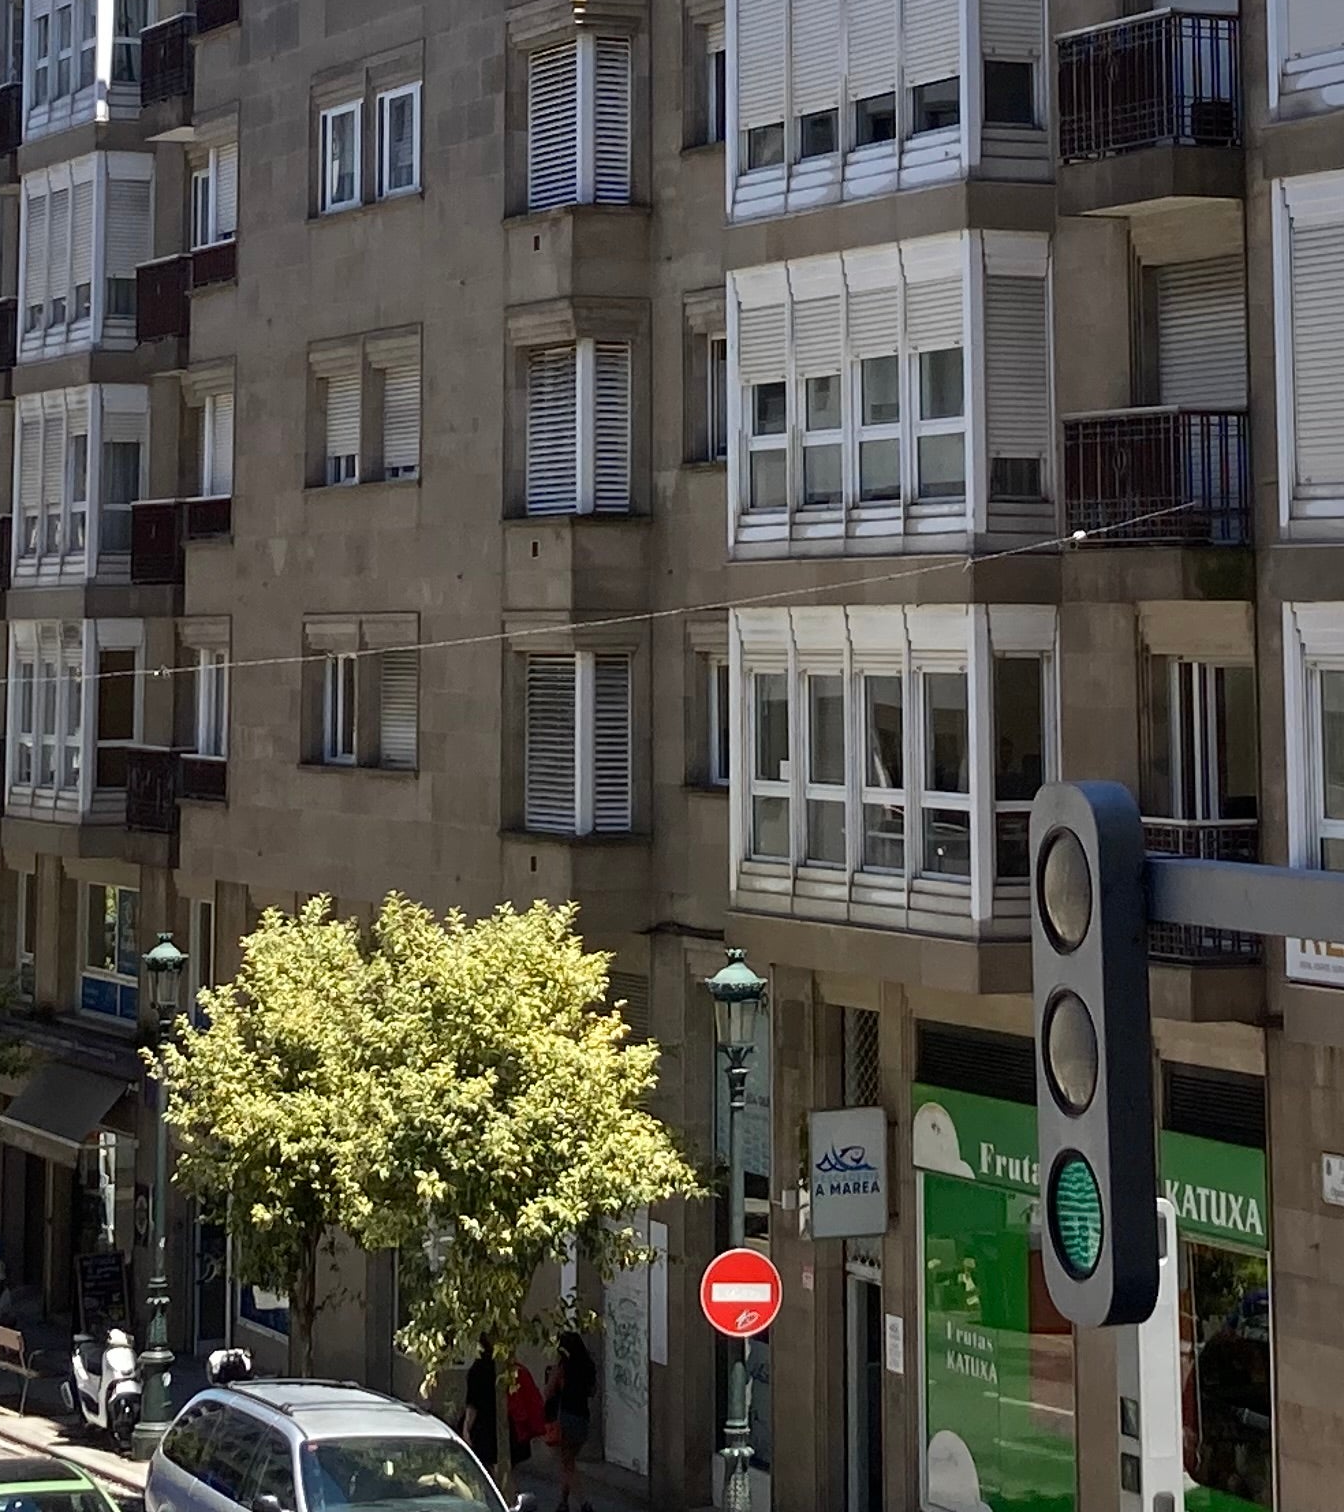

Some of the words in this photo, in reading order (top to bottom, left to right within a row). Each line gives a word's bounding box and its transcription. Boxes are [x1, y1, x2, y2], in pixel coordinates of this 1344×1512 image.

[979, 1142, 1040, 1185] Fruta
[816, 1183, 825, 1197] A
[830, 1181, 881, 1195] MAREA
[1165, 1179, 1264, 1236] KATUXA
[946, 1350, 998, 1384] KATUXA
